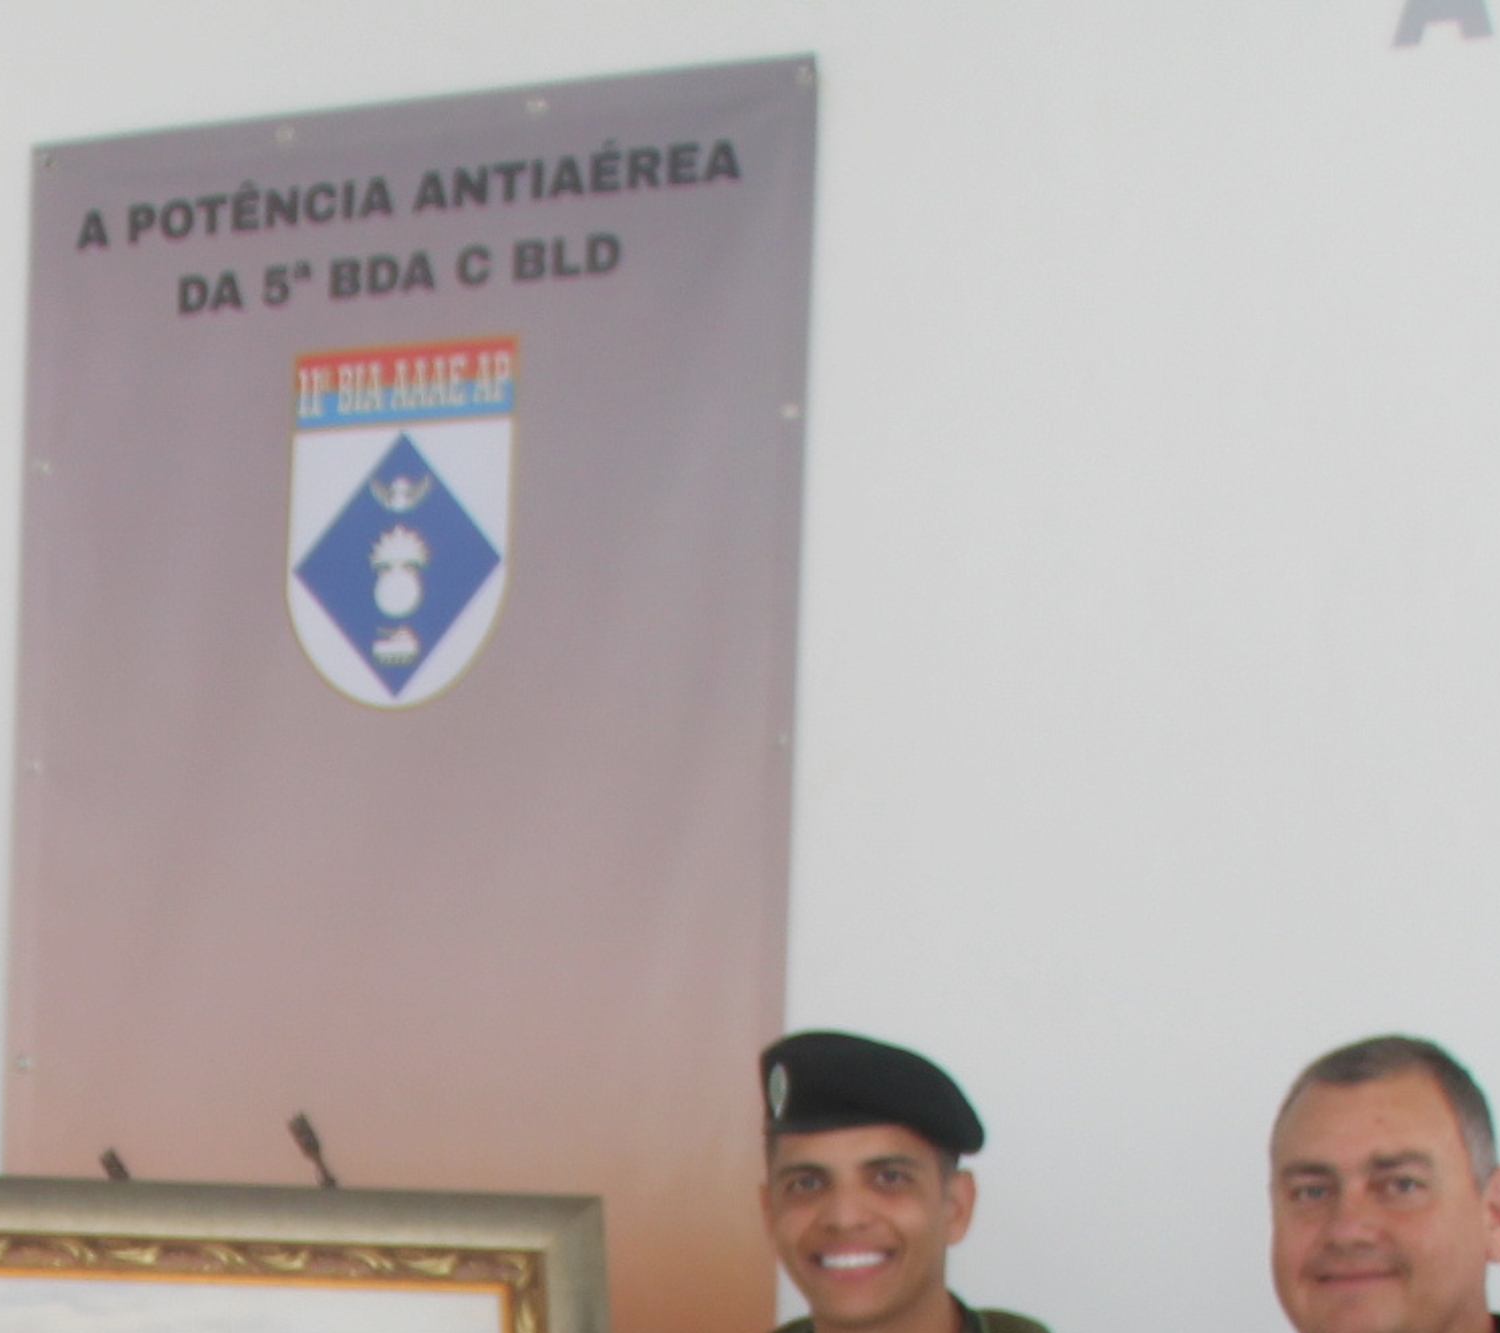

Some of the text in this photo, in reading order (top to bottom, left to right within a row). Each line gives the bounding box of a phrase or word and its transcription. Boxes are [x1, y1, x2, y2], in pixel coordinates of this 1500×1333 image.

[76, 138, 741, 250] A POTÊNCIA ANTIAÉREA
[178, 269, 244, 315] DA
[328, 248, 436, 300] BDA
[456, 244, 492, 288] C
[512, 231, 622, 284] BLD
[337, 360, 383, 416] BIA
